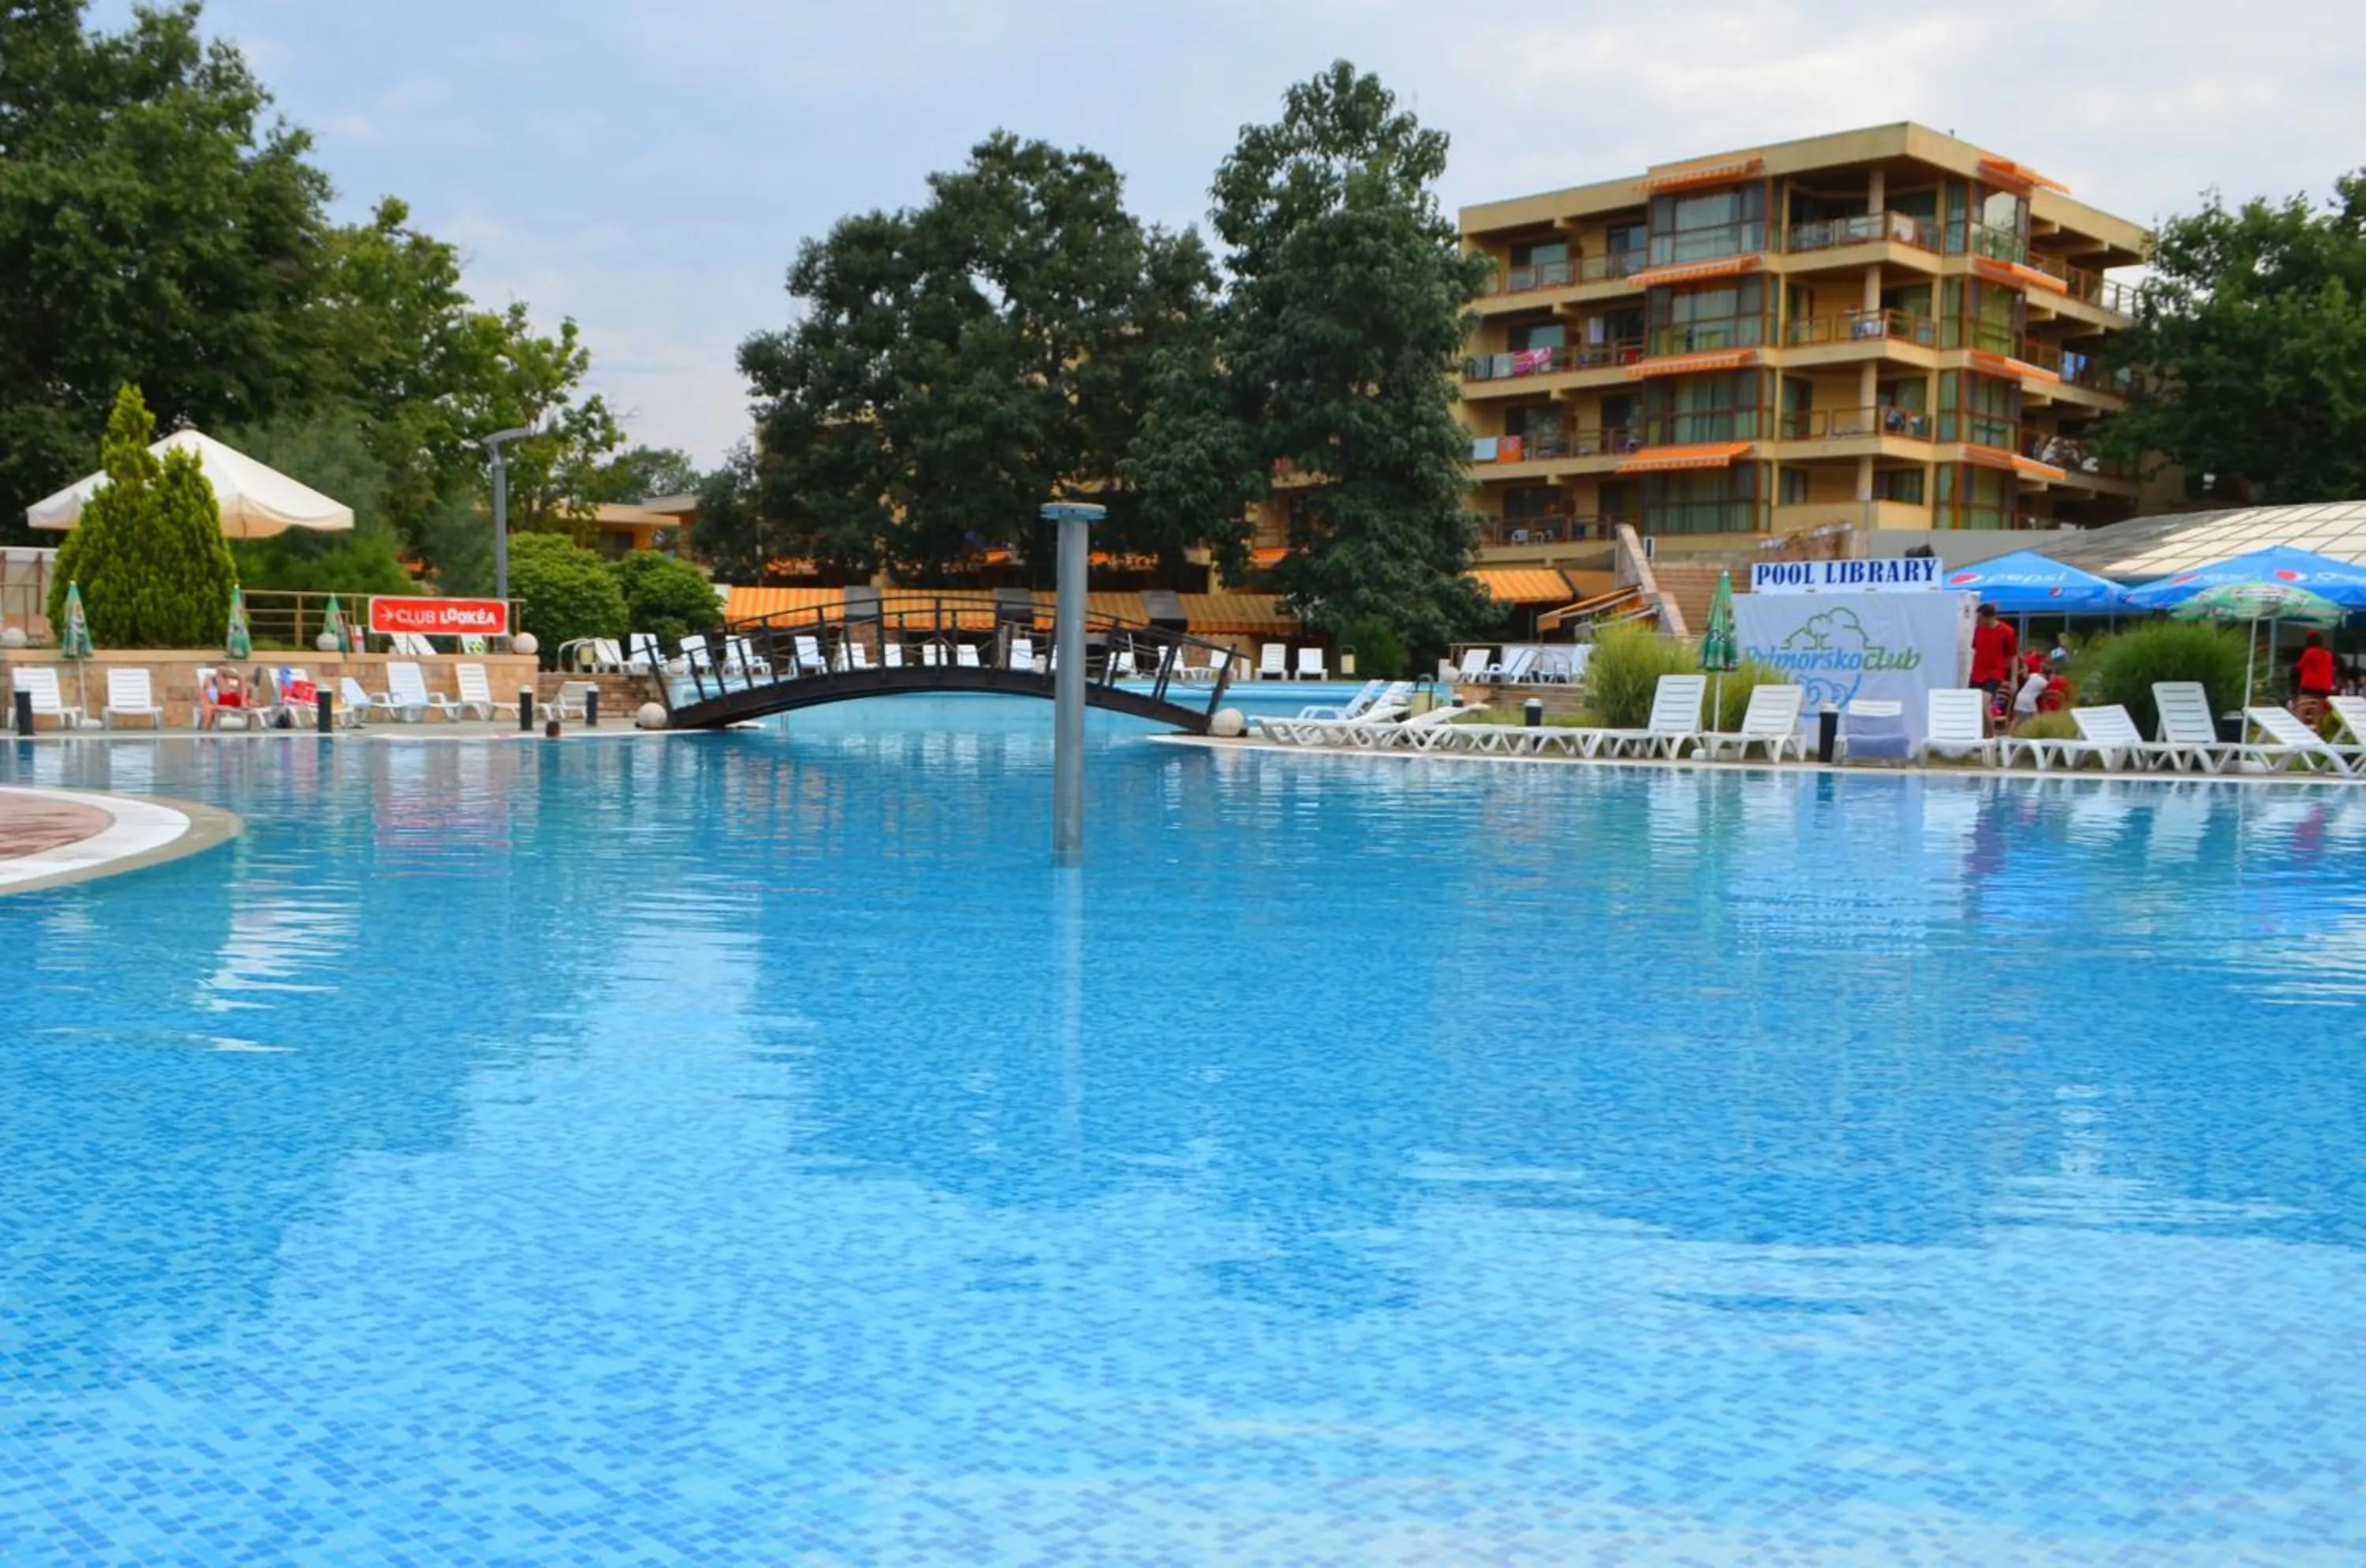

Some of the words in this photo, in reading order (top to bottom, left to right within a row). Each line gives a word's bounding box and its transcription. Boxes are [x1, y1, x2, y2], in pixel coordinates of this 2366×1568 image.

[1756, 562, 1815, 585] POOL
[1825, 559, 1937, 583] LIBRARY
[395, 608, 435, 624] CLUB
